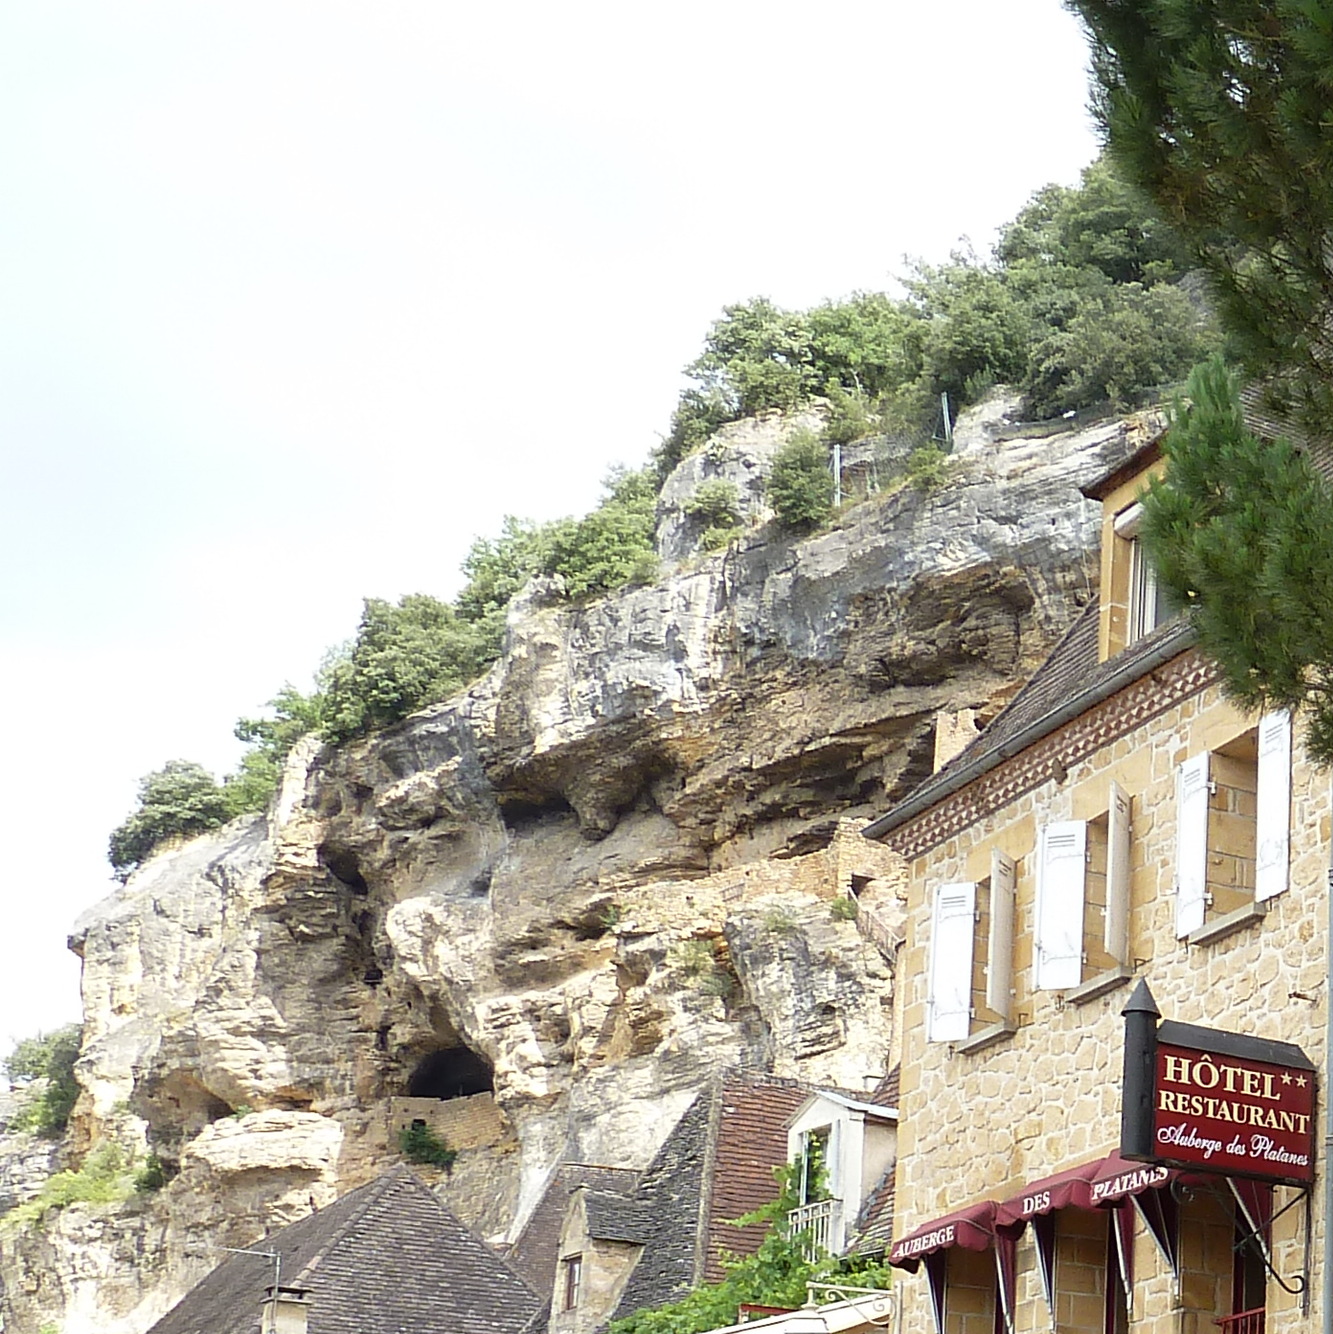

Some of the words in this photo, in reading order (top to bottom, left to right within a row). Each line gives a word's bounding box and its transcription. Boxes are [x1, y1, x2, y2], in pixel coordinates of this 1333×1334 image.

[1163, 1053, 1281, 1101] HÔTEL
[1158, 1090, 1310, 1134] RESTAURANT
[1157, 1123, 1222, 1160] Auberge
[1226, 1134, 1246, 1156] des
[1249, 1134, 1309, 1167] Platanes
[892, 1225, 955, 1258] AUBERGE
[1022, 1191, 1050, 1215] DES
